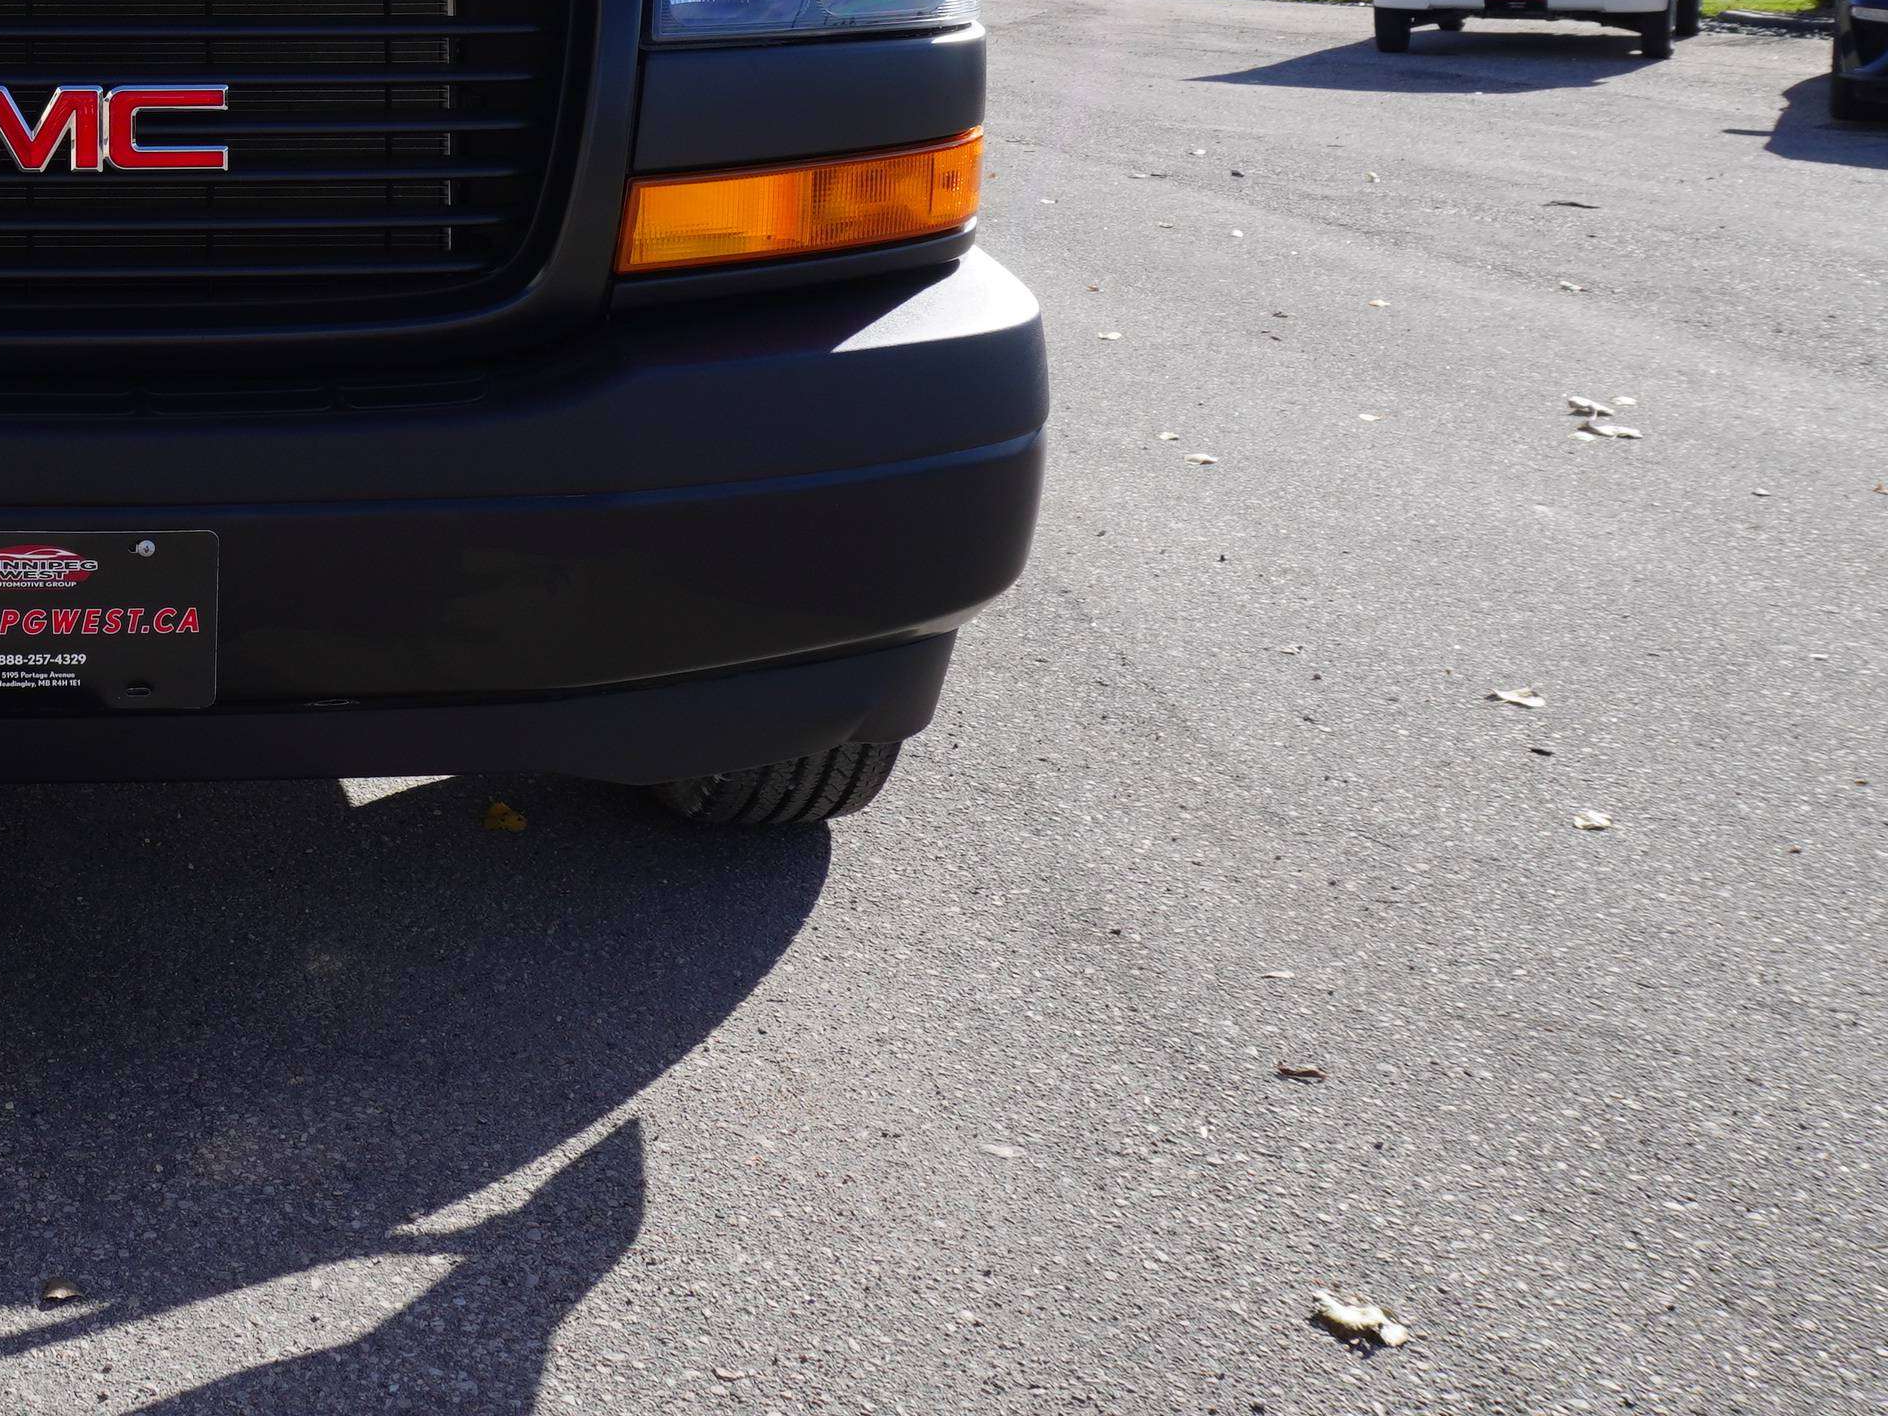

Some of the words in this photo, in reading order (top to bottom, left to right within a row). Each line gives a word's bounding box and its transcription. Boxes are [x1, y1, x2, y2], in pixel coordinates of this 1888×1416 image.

[1, 671, 19, 679] 5195
[20, 671, 48, 680] Portage
[49, 670, 76, 679] Avenue
[38, 679, 51, 687] MB
[52, 679, 68, 687] R4H
